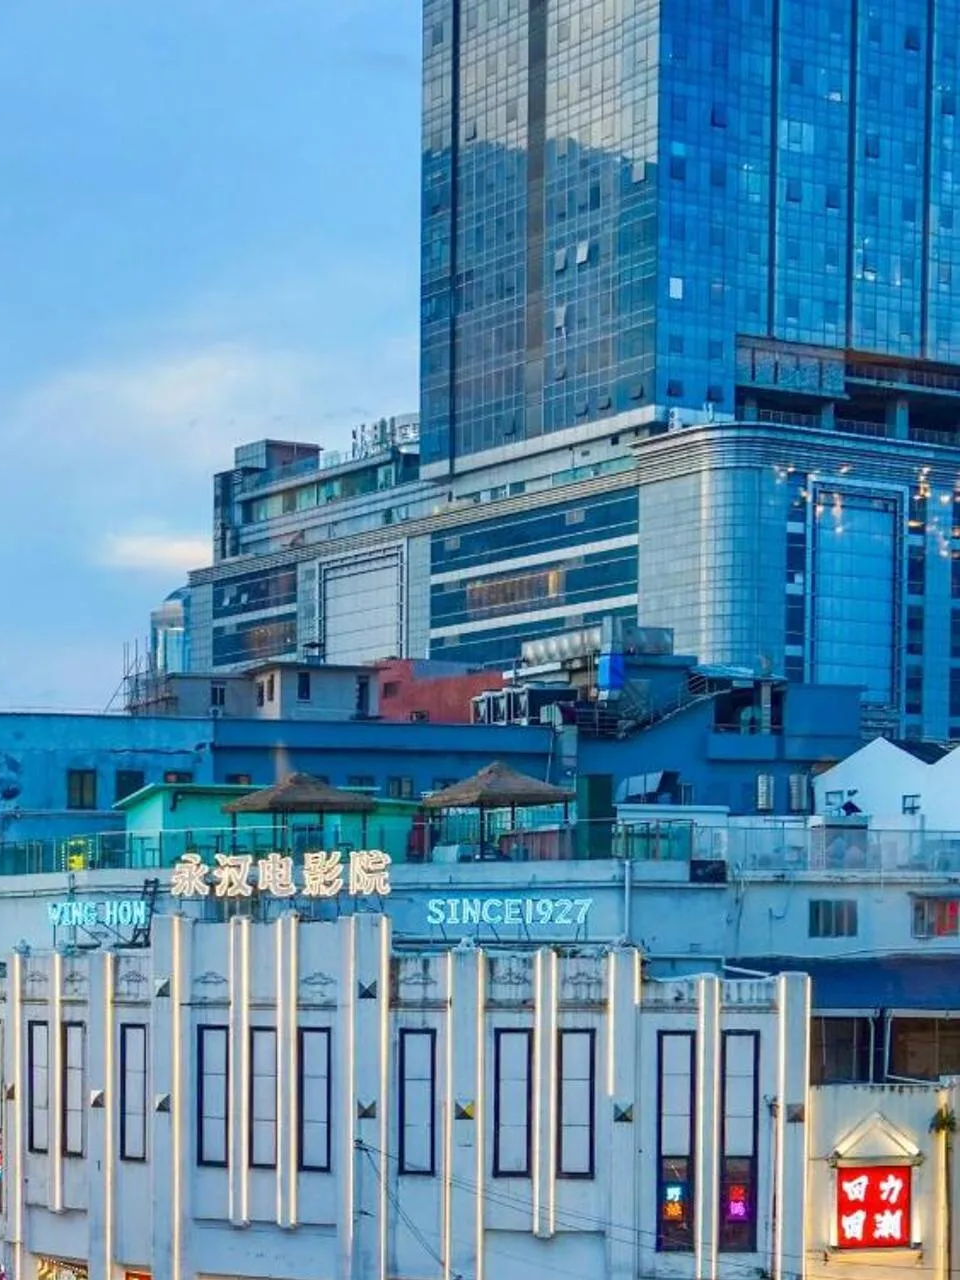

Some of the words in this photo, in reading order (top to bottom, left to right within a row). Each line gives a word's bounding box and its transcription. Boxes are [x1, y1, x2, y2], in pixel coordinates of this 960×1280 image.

[171, 850, 391, 897] 永汉电影院
[104, 900, 145, 925] HON
